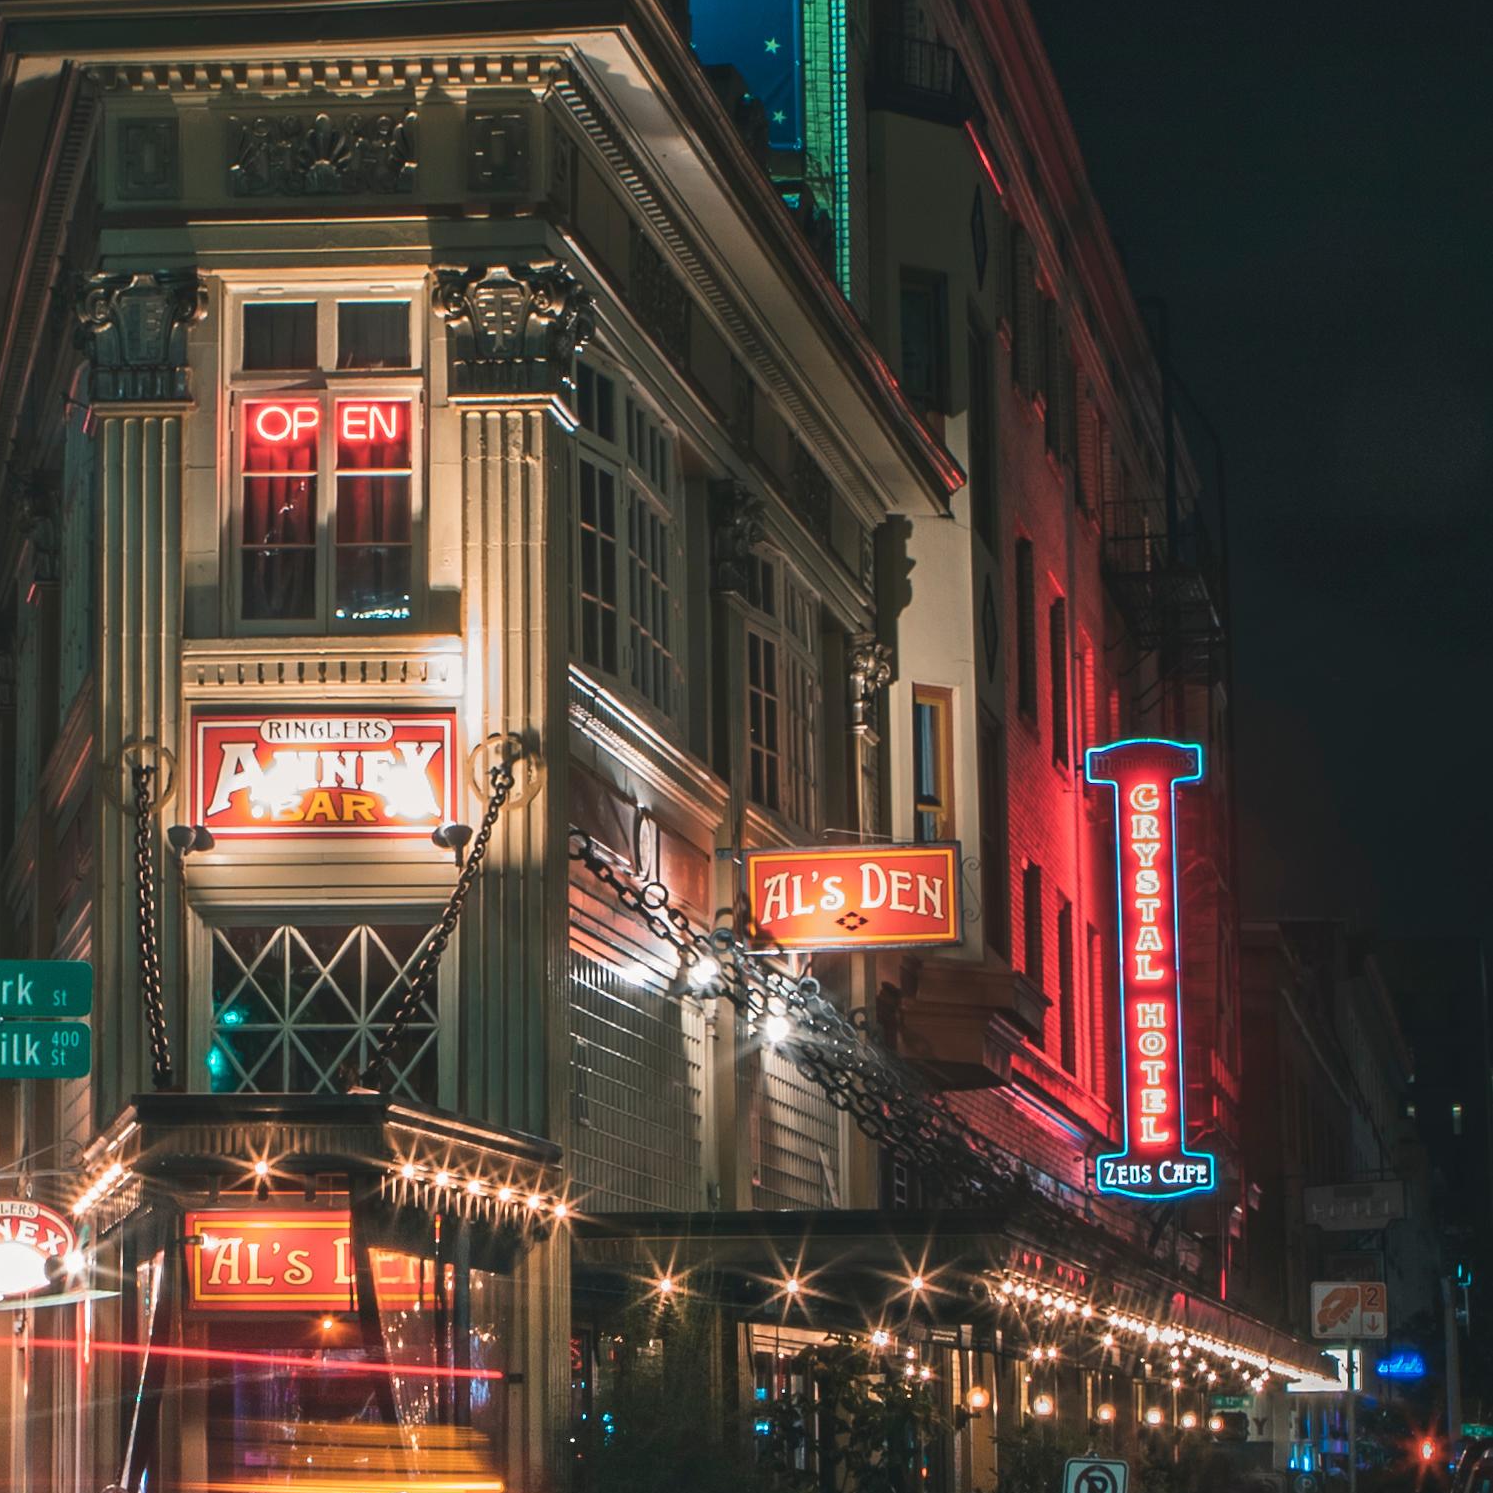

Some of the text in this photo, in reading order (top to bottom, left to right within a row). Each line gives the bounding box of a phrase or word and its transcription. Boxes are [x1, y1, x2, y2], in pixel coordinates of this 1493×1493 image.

[256, 406, 397, 441] OPEN
[269, 721, 387, 739] RINGLERS
[206, 741, 443, 818] ANNEX
[271, 791, 379, 822] BAR
[860, 862, 944, 919] DEN
[1130, 783, 1169, 1144] CRYSTAL HOTEL
[53, 989, 67, 1006] St
[51, 1031, 79, 1047] 400
[51, 1049, 67, 1066] St
[1366, 1287, 1379, 1306] 2
